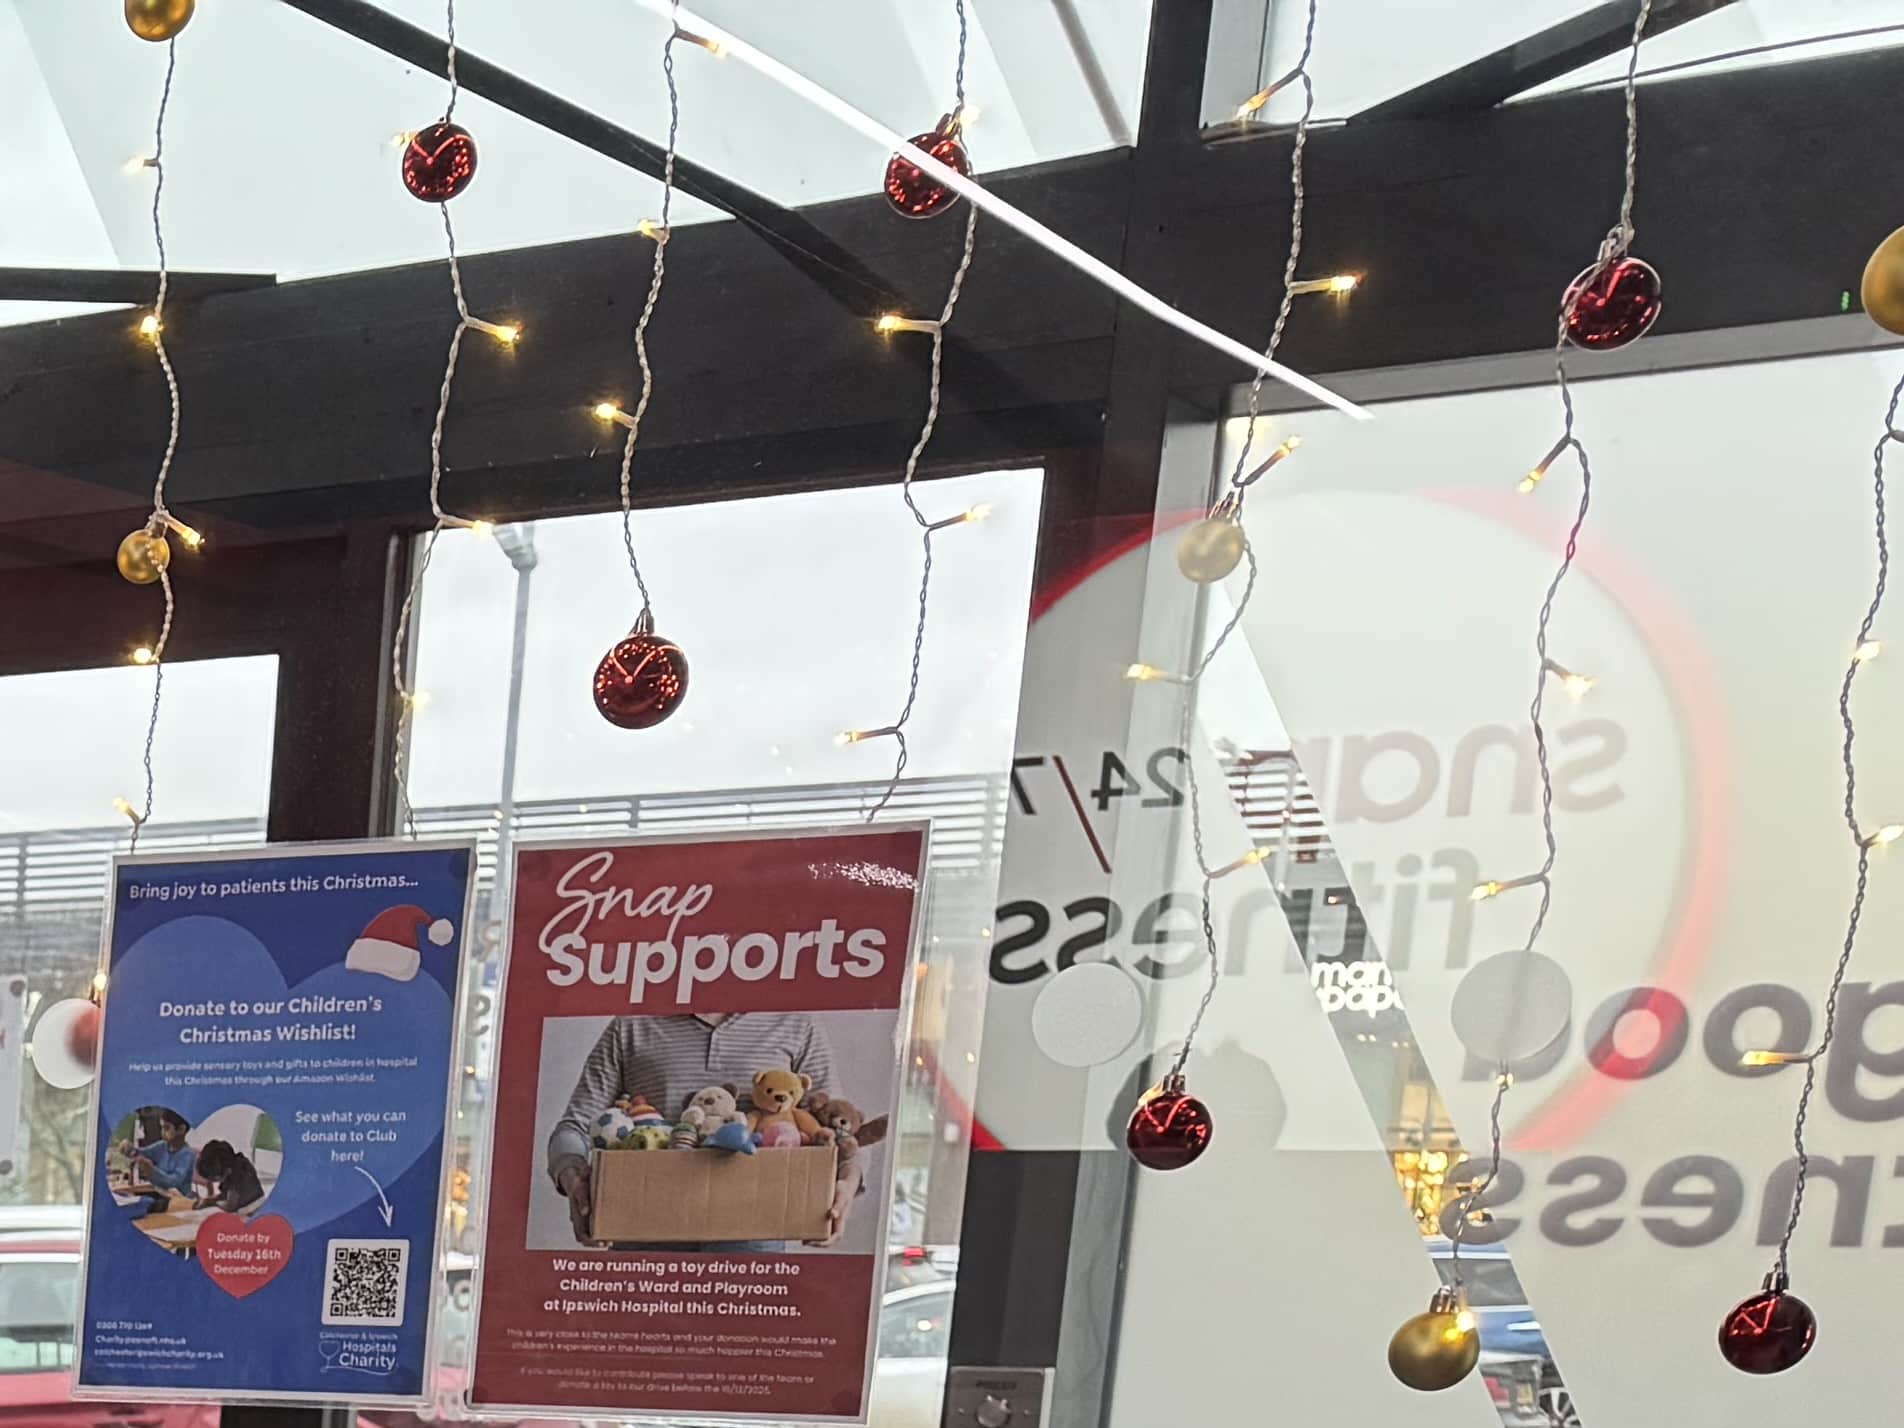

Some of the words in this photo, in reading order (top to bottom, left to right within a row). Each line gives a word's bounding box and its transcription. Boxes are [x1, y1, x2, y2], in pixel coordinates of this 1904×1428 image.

[129, 883, 170, 900] Bring
[173, 881, 196, 899] joy
[220, 878, 286, 897] patients
[290, 876, 320, 891] this
[323, 873, 419, 890] Christmas...
[539, 851, 713, 954] Snap
[545, 917, 886, 1004] Supports
[159, 1000, 225, 1017] Donate
[253, 1001, 285, 1015] our
[287, 995, 382, 1014] Children's
[179, 1026, 272, 1044] Christmas
[276, 1024, 356, 1041] Wishlist!
[295, 1111, 319, 1123] See
[321, 1110, 353, 1123] what
[356, 1112, 380, 1127] you
[382, 1111, 407, 1123] can
[301, 1129, 347, 1143] donate
[366, 1129, 397, 1142] Club
[331, 1149, 364, 1163] here!
[217, 1232, 253, 1244] Donate
[255, 1232, 270, 1246] by
[207, 1247, 253, 1262] Tuesday
[213, 1263, 269, 1275] December
[552, 1258, 576, 1271] We
[579, 1261, 603, 1272] are
[606, 1260, 665, 1276] running
[681, 1261, 704, 1277] toy
[709, 1260, 747, 1274] drive
[750, 1261, 771, 1275] for
[774, 1261, 800, 1275] the
[559, 1279, 635, 1293] Children's
[638, 1280, 679, 1293] Ward
[682, 1281, 711, 1294] and
[714, 1282, 789, 1298] Playroom
[562, 1299, 619, 1315] Ipswich
[621, 1300, 683, 1317] Hospital
[686, 1301, 714, 1315] this
[717, 1303, 801, 1317] Christmas.
[342, 1340, 397, 1354] Hospitals
[338, 1353, 396, 1370] Charity
